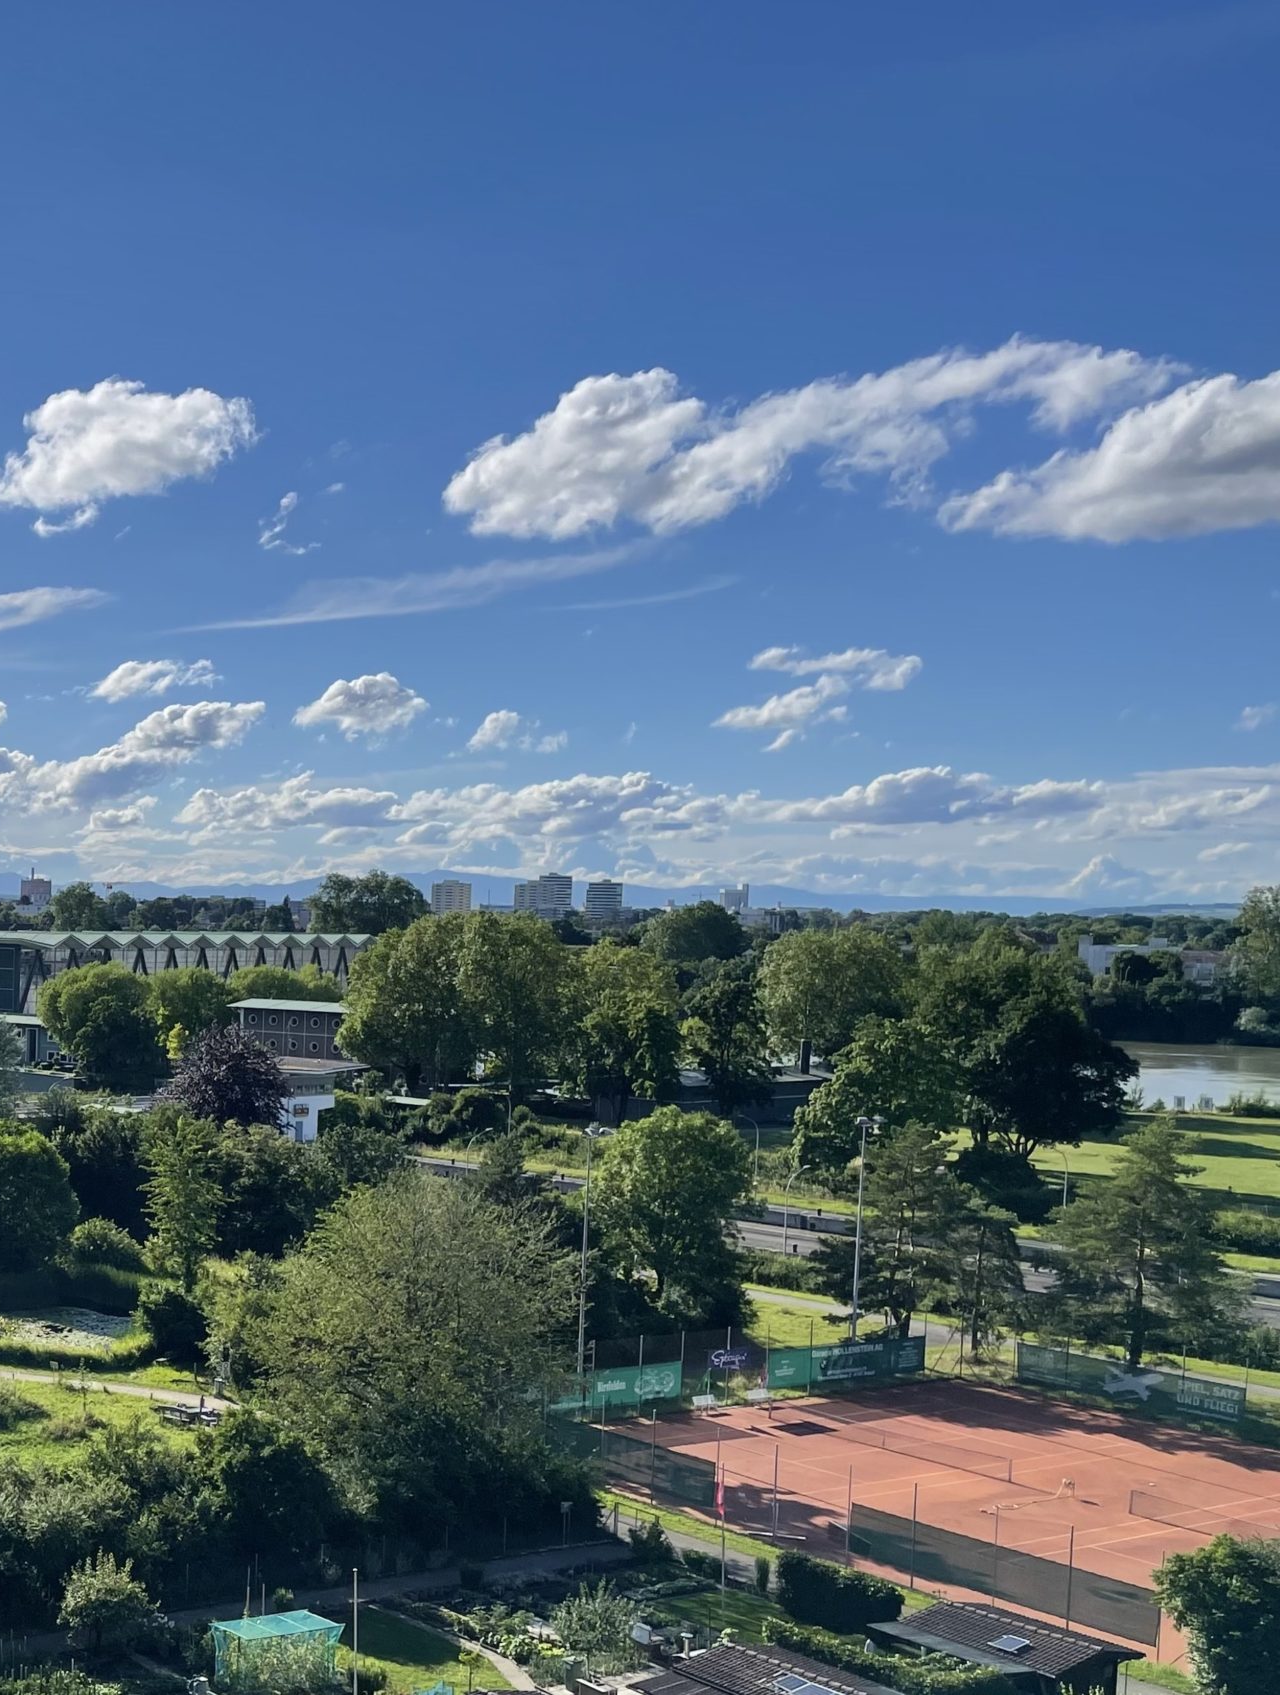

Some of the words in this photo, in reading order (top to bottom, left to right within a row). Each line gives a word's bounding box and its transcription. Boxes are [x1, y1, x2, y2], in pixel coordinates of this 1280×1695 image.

[1177, 1379, 1210, 1396] SPIEL,
[1213, 1386, 1240, 1400] SATZ
[1176, 1393, 1200, 1406] UND
